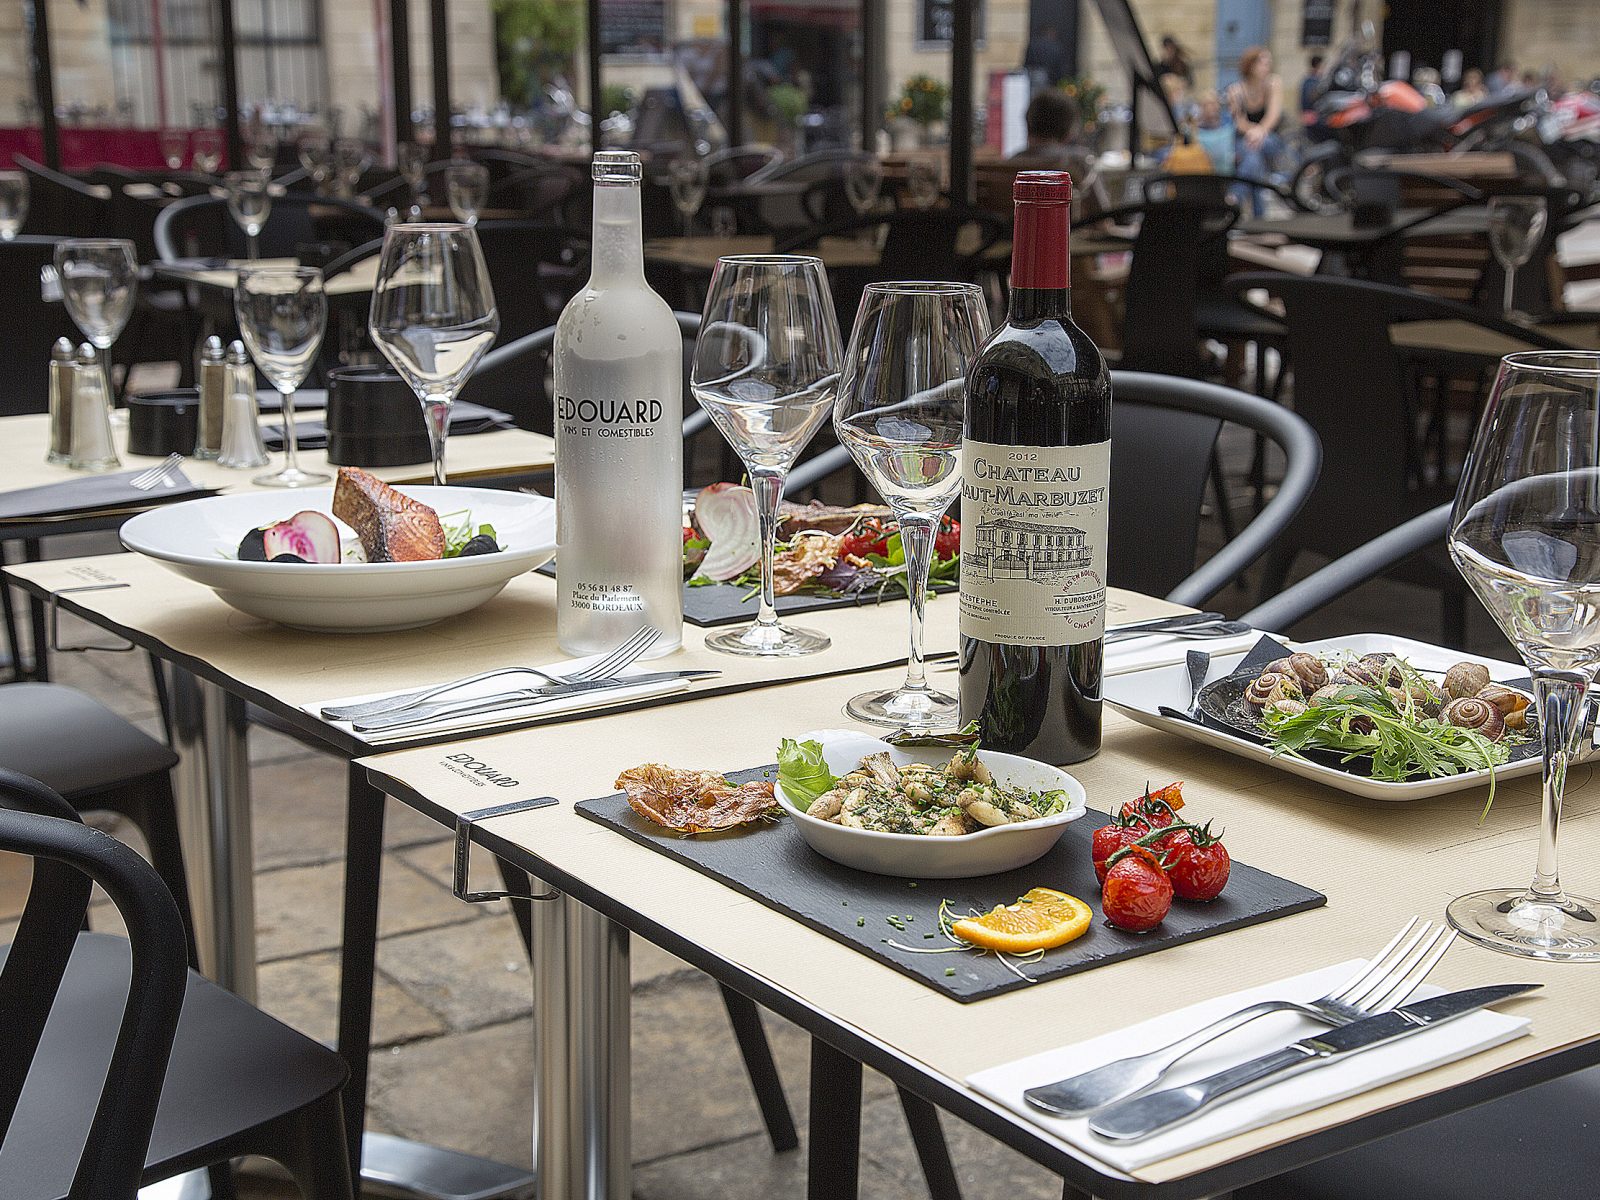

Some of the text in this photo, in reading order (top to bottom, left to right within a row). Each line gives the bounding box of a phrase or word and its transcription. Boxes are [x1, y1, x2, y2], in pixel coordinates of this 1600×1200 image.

[558, 396, 662, 423] EDOUARD
[581, 427, 592, 437] ET
[597, 427, 654, 438] COMESTIBLES
[1008, 452, 1038, 461] 2012
[973, 457, 1082, 482] CHATEAU
[577, 582, 633, 593] 05 56 81 48 87
[572, 590, 589, 600] Place
[589, 592, 600, 601] du
[571, 599, 643, 612] 33000 BORDEAUX
[445, 753, 519, 788] EDOUARD
